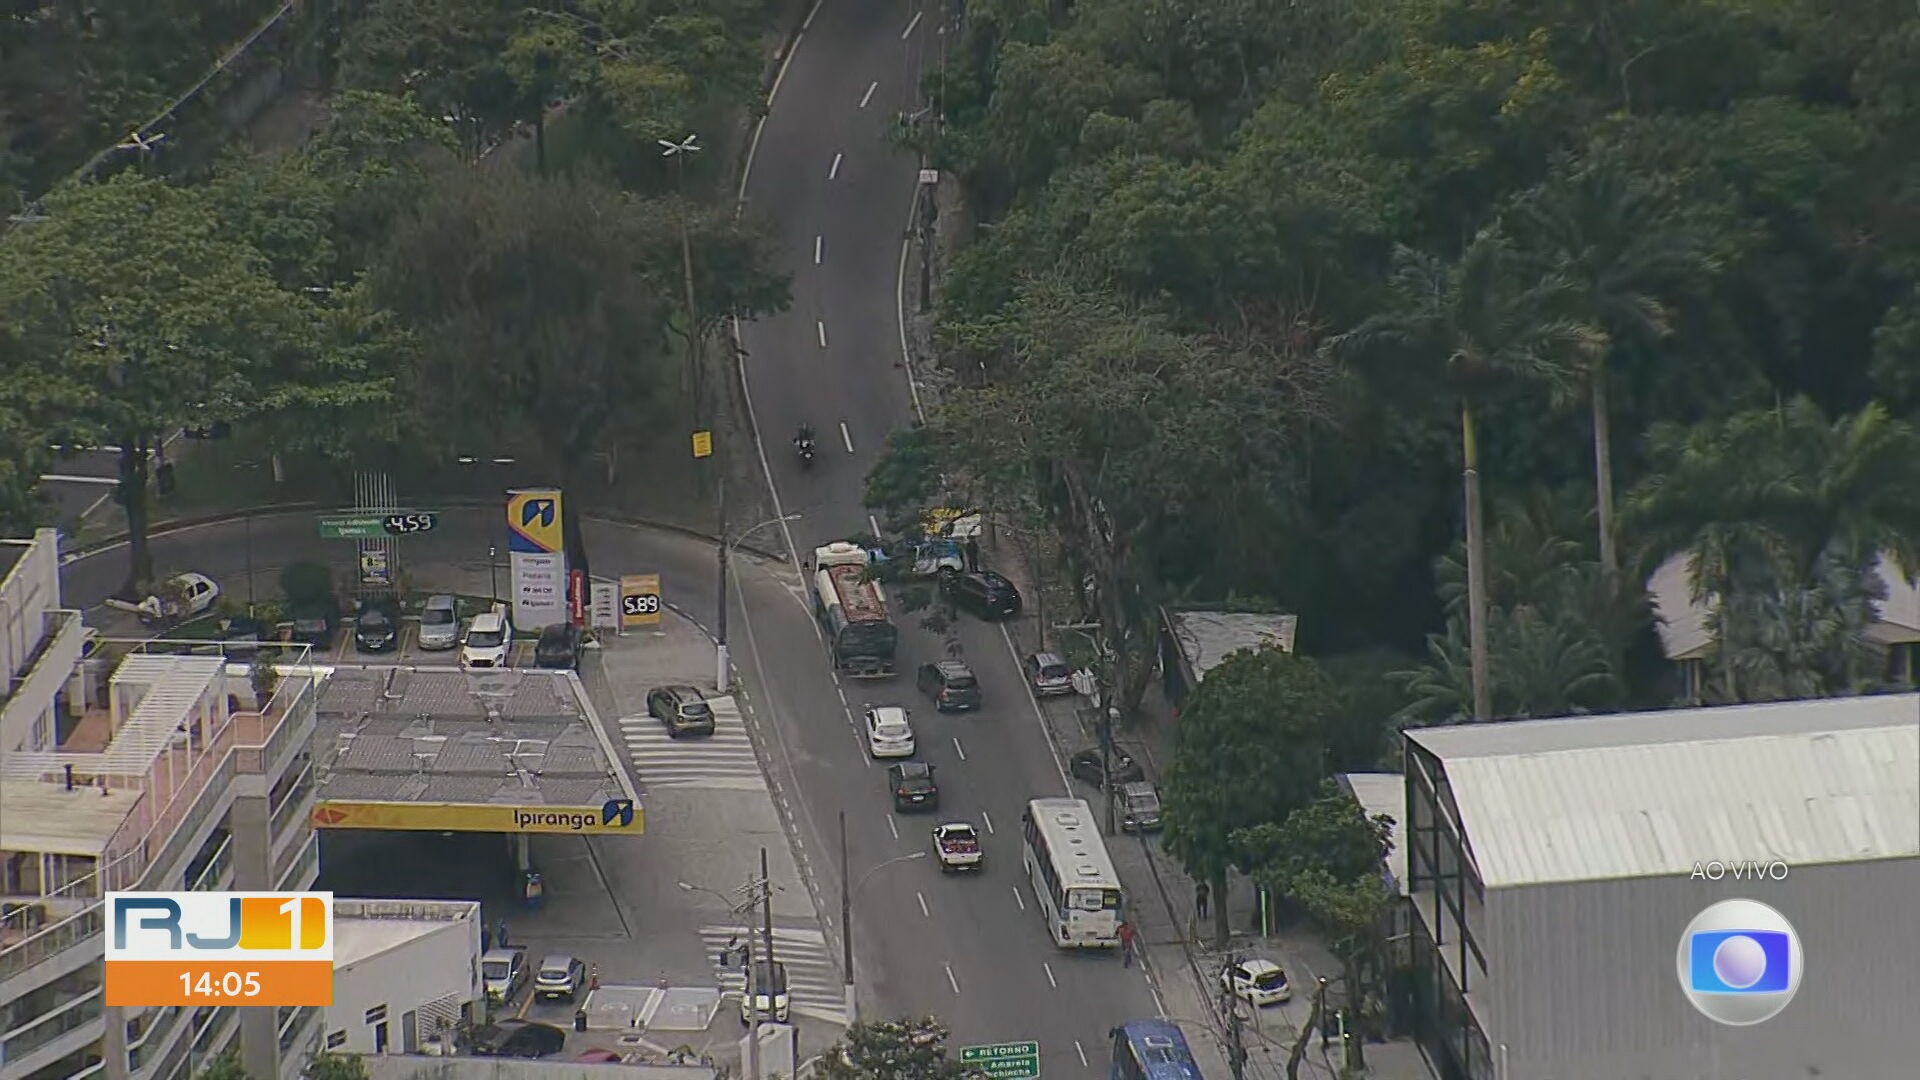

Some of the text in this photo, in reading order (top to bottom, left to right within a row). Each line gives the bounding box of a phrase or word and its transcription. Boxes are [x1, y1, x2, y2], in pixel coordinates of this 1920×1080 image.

[624, 595, 658, 614] 5.89
[513, 809, 596, 830] Ipiranga
[980, 1045, 1029, 1056] RETORNO
